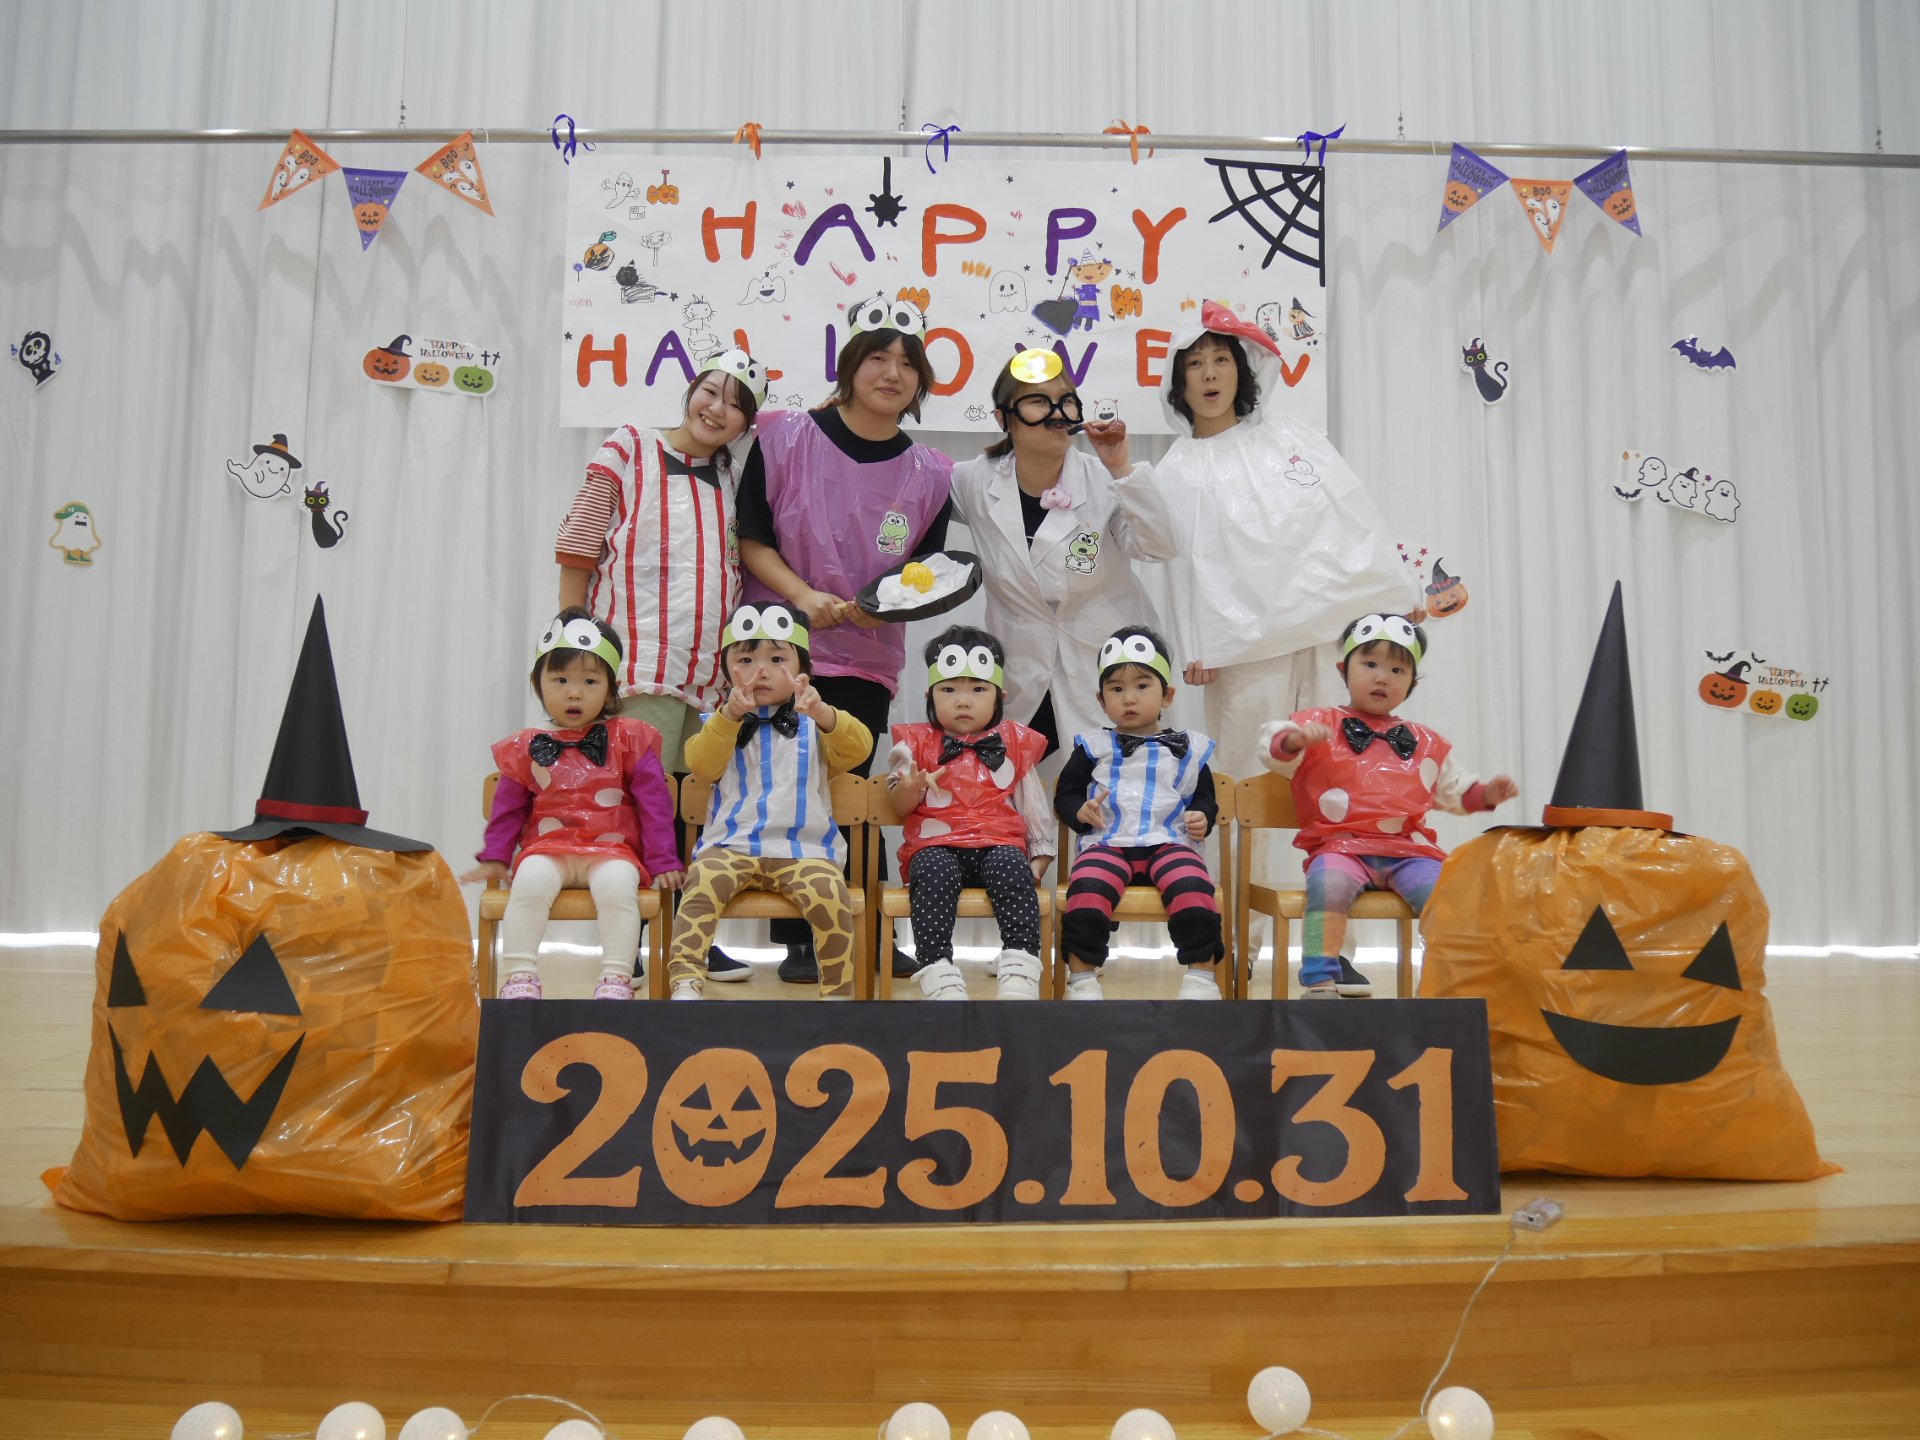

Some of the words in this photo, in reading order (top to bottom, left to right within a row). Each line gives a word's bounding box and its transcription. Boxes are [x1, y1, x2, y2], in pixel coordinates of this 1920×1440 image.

[299, 150, 318, 166] BOO
[441, 149, 458, 168] BOO
[1463, 160, 1489, 176] HAPPY
[360, 179, 385, 188] HAPPY
[1533, 186, 1552, 196] BOO
[701, 200, 1188, 285] HAPPY
[430, 340, 466, 352] HAPPY
[420, 348, 474, 361] HALLOWEEN
[1770, 668, 1801, 678] HAPPY
[1758, 676, 1807, 688] HALLOWEEN
[514, 1031, 1468, 1208] 2025.10.31
